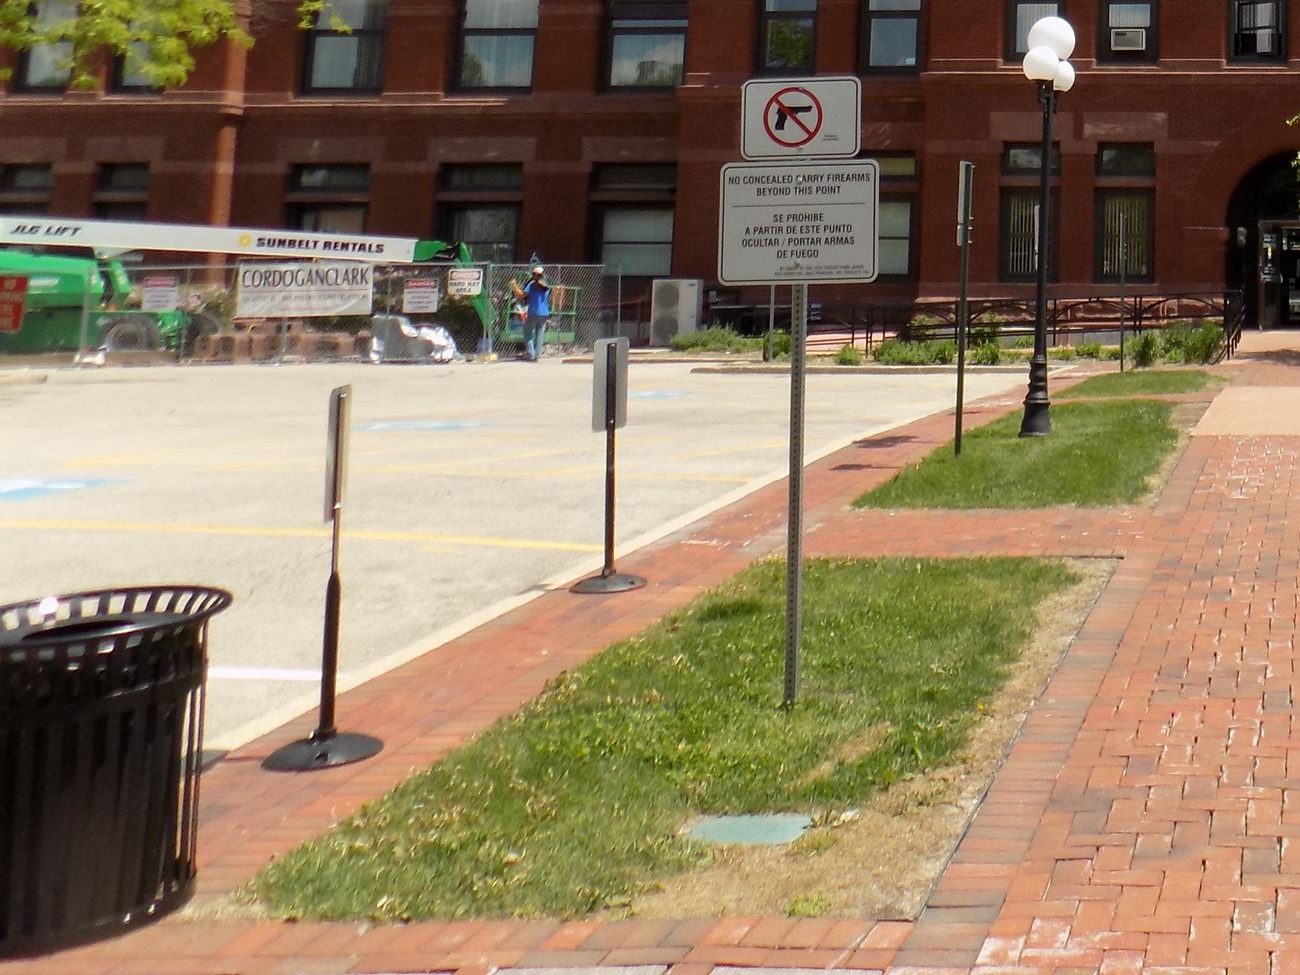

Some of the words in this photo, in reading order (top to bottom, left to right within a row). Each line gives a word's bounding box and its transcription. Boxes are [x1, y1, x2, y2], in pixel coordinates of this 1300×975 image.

[728, 176, 740, 185] NO
[743, 175, 793, 185] CONCEALED
[796, 174, 824, 184] CARRY
[827, 173, 871, 183] FIREARMS
[756, 187, 791, 196] BEYOND
[795, 186, 813, 195] THIS
[816, 185, 841, 195] POINT
[773, 214, 784, 223] SE
[787, 213, 824, 222] PROHIBE
[10, 224, 40, 235] JLG
[43, 225, 82, 237] LIFT
[745, 227, 751, 235] A
[753, 226, 784, 235] PARTIR
[787, 226, 797, 235] DE
[800, 225, 821, 234] ESTE
[824, 224, 853, 233] PUNTO
[256, 237, 319, 250] SUNBELT
[322, 240, 385, 254] RENTALS
[742, 238, 780, 247] OCULTAR
[788, 237, 822, 246] PORTAR
[824, 236, 855, 245] ARMAS
[777, 250, 788, 259] DE
[791, 249, 819, 258] FUEGO
[242, 267, 369, 288] CORDOGANCLARK
